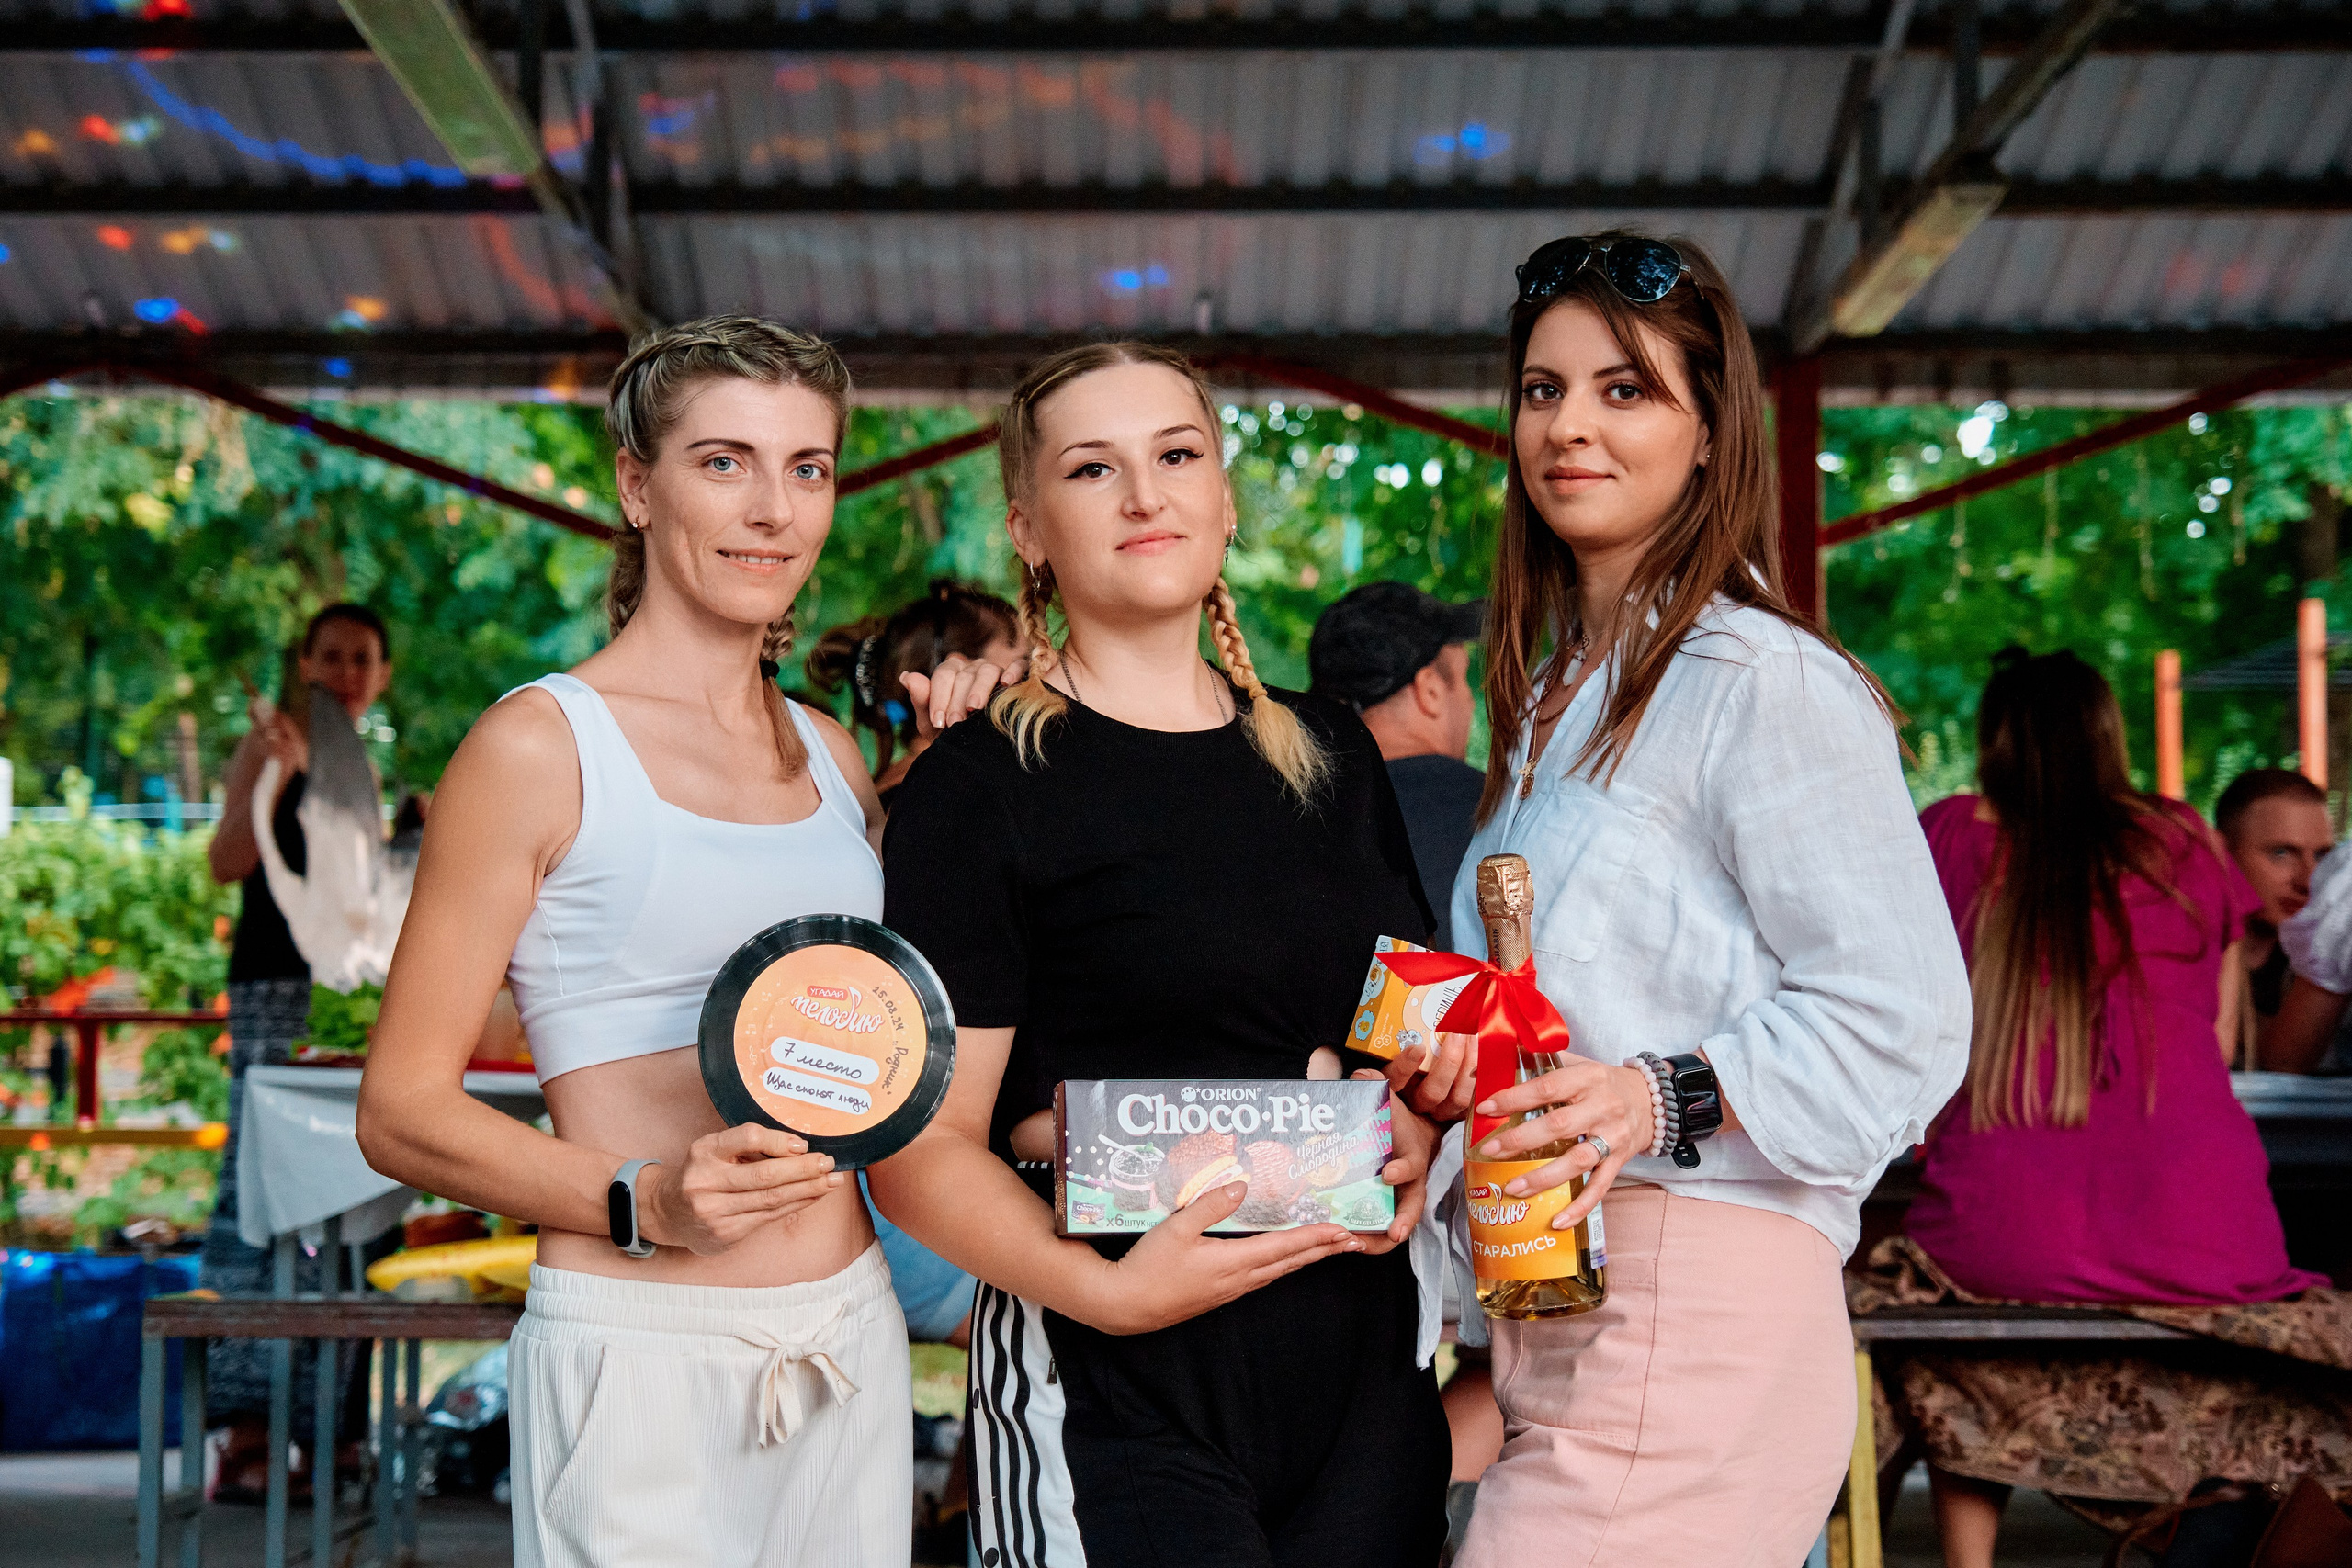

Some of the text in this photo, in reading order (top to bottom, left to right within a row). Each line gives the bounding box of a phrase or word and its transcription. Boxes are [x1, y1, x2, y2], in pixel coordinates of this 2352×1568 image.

[809, 987, 844, 999] УГАДАЙ
[872, 986, 904, 1031] 25.08.24
[784, 1042, 862, 1079] 7 место
[1200, 1088, 1258, 1100] ORION
[1288, 1135, 1360, 1179] Смородина
[1297, 1132, 1342, 1159] Чёрная
[1473, 1235, 1557, 1258] СТАРАЛИСЬ
